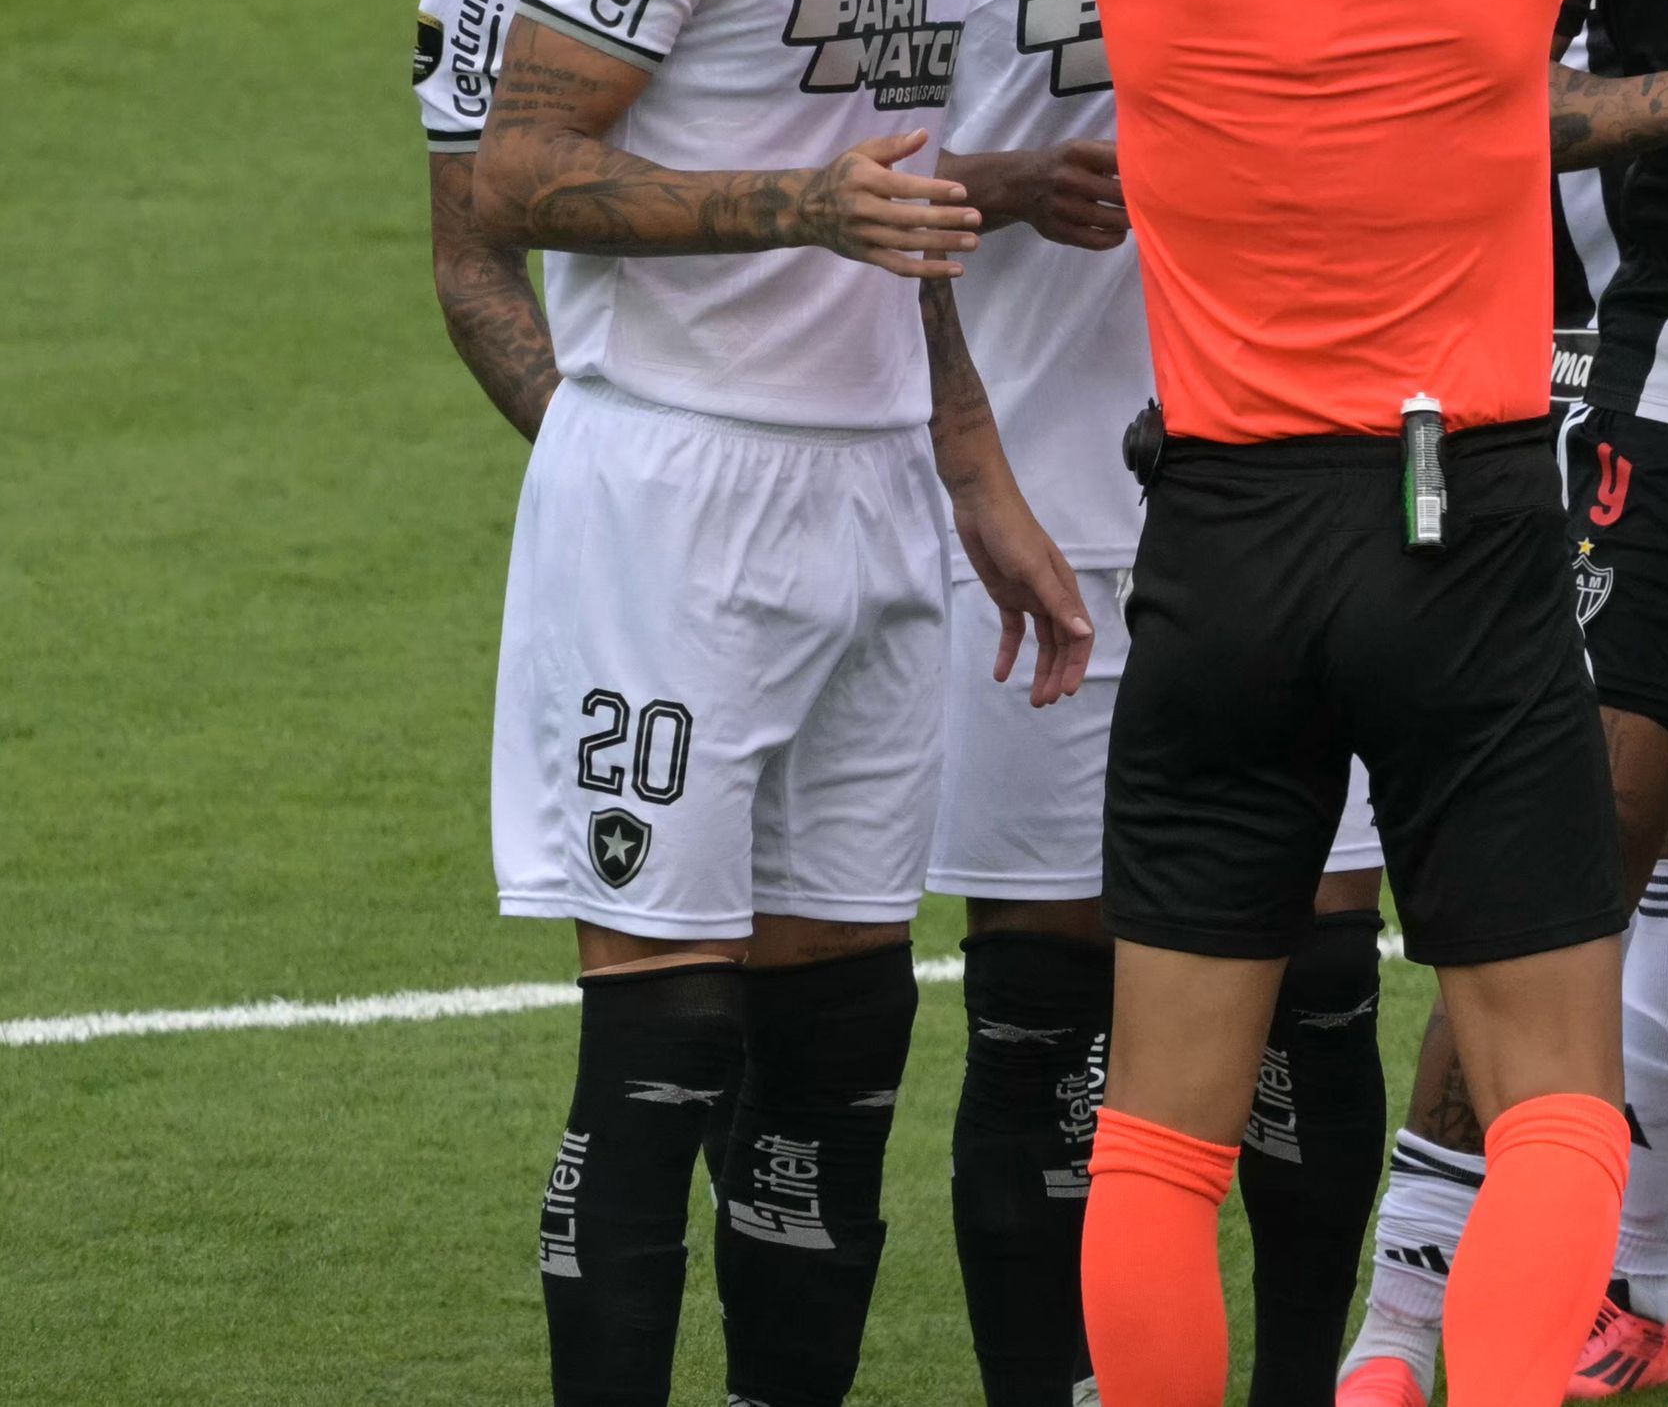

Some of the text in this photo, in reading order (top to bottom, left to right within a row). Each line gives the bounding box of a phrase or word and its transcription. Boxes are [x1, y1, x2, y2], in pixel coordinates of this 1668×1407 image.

[578, 687, 694, 806] 20
[1054, 1071, 1096, 1146] ifefit
[753, 1134, 821, 1219] Lifefit
